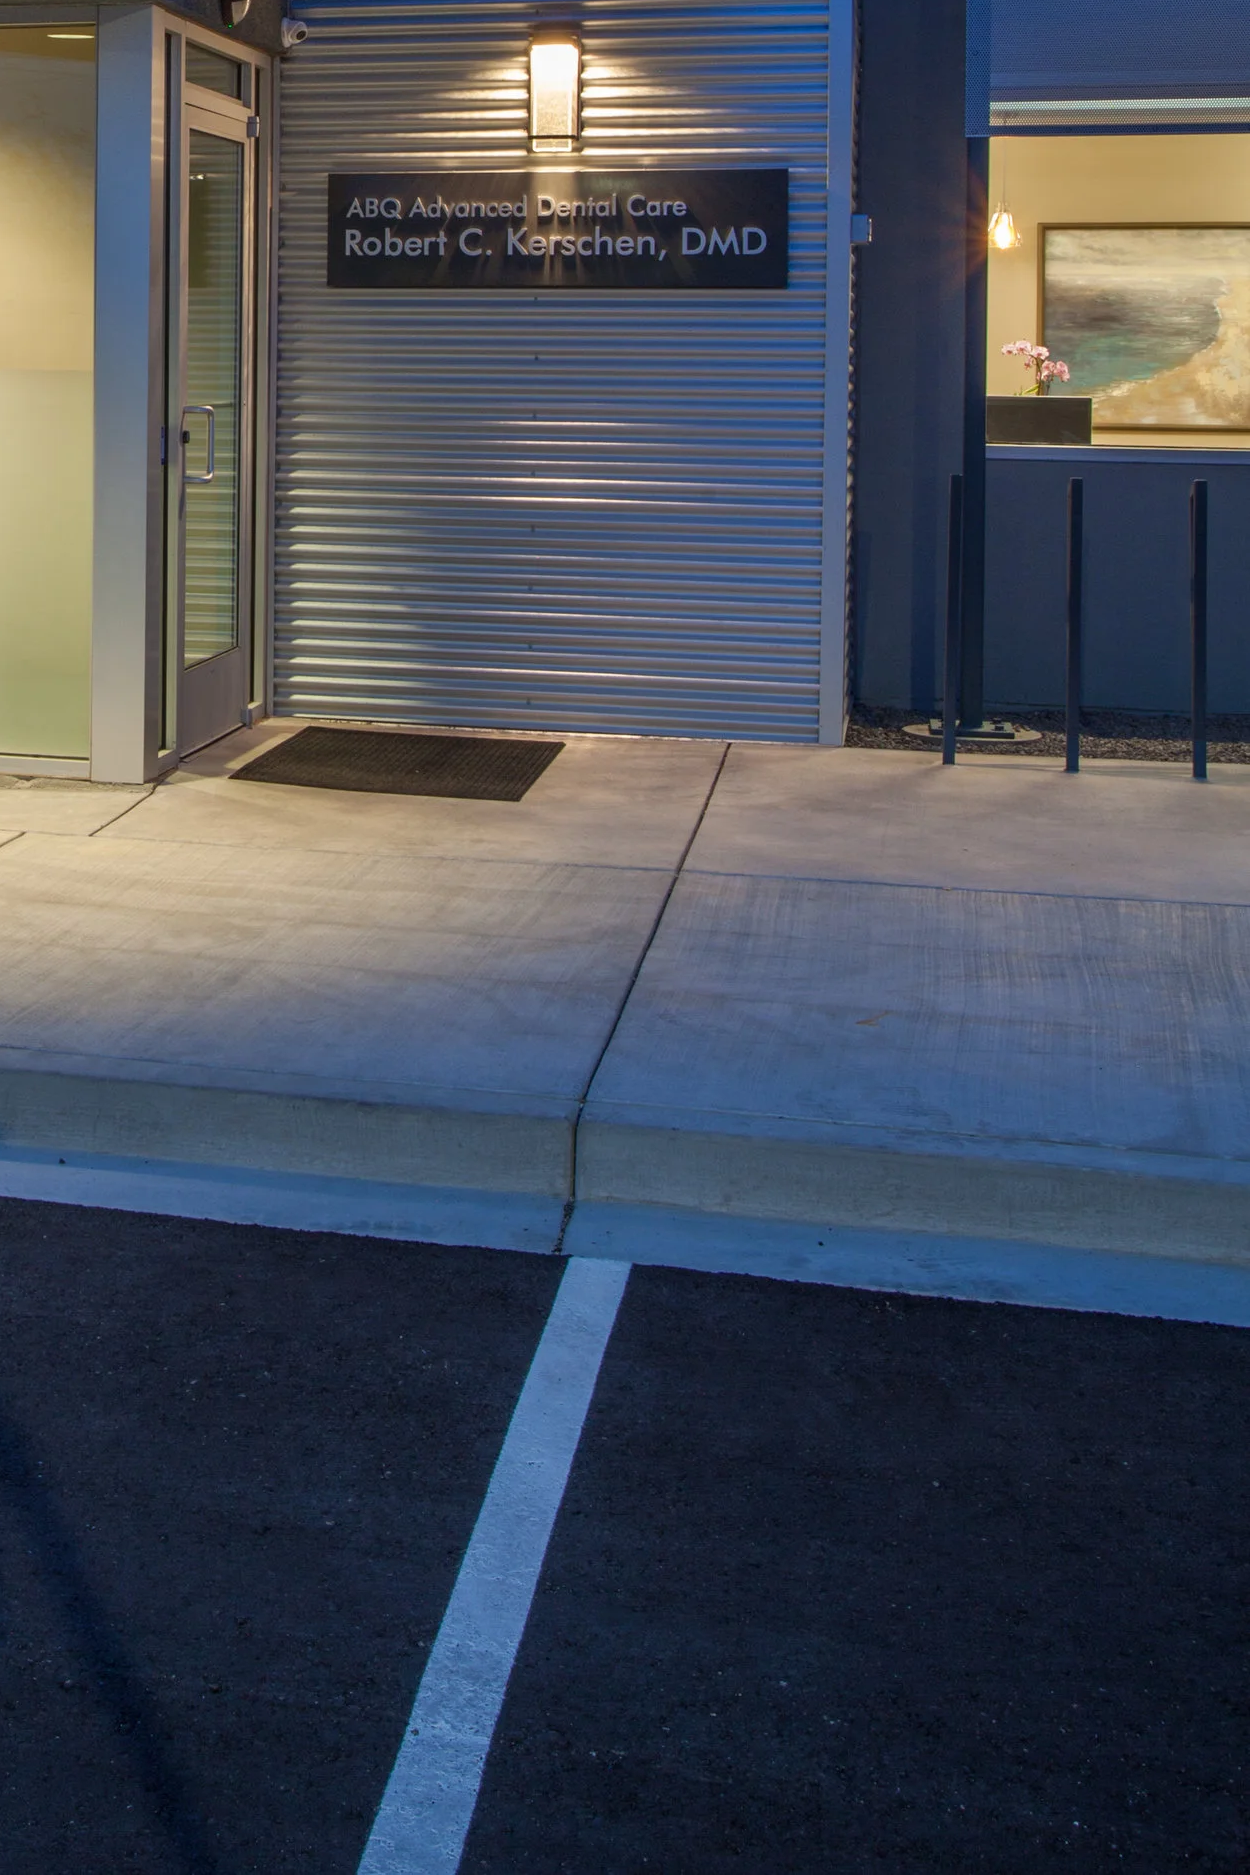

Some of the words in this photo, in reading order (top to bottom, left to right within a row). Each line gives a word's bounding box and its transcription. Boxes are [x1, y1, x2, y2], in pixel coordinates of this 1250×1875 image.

[346, 197, 402, 220] ABQ
[409, 195, 527, 220] Advanced
[537, 194, 617, 217] Dental
[626, 194, 687, 217] Care
[345, 229, 448, 256] Robert
[459, 230, 492, 256] C.
[507, 227, 667, 261] Kerschen,
[681, 227, 768, 256] DMD
